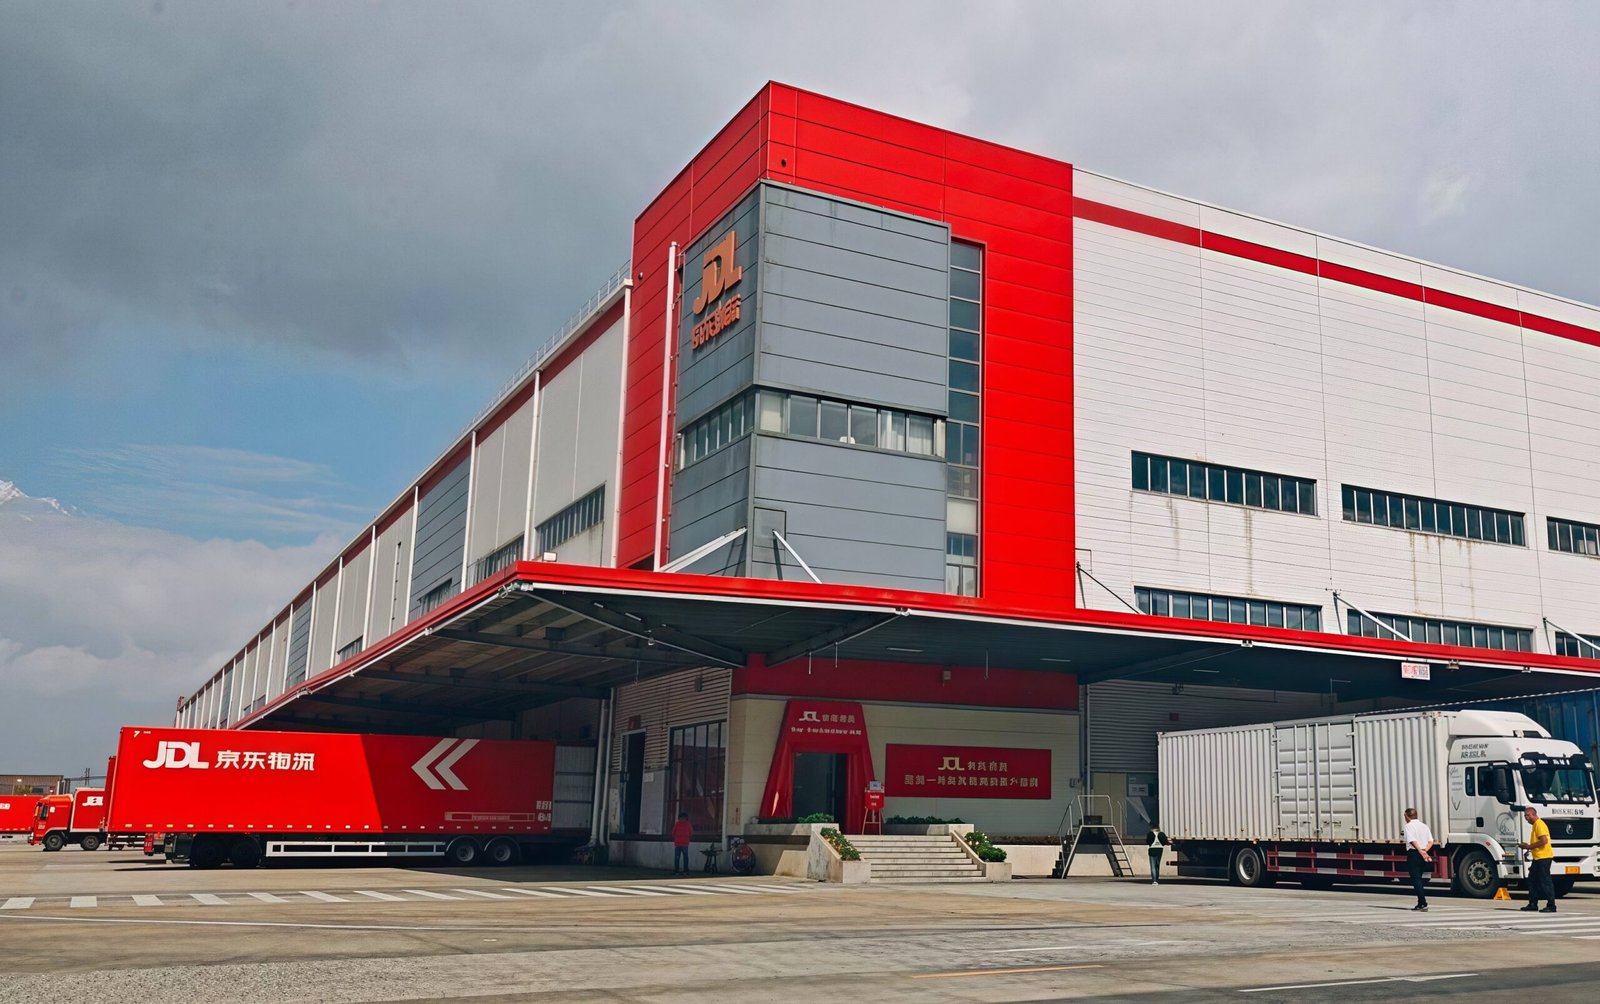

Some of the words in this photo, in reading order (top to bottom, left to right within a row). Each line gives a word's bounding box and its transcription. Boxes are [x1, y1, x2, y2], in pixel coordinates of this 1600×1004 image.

[692, 230, 742, 315] JDL
[142, 741, 209, 769] JDL
[214, 750, 315, 771] 京东物流
